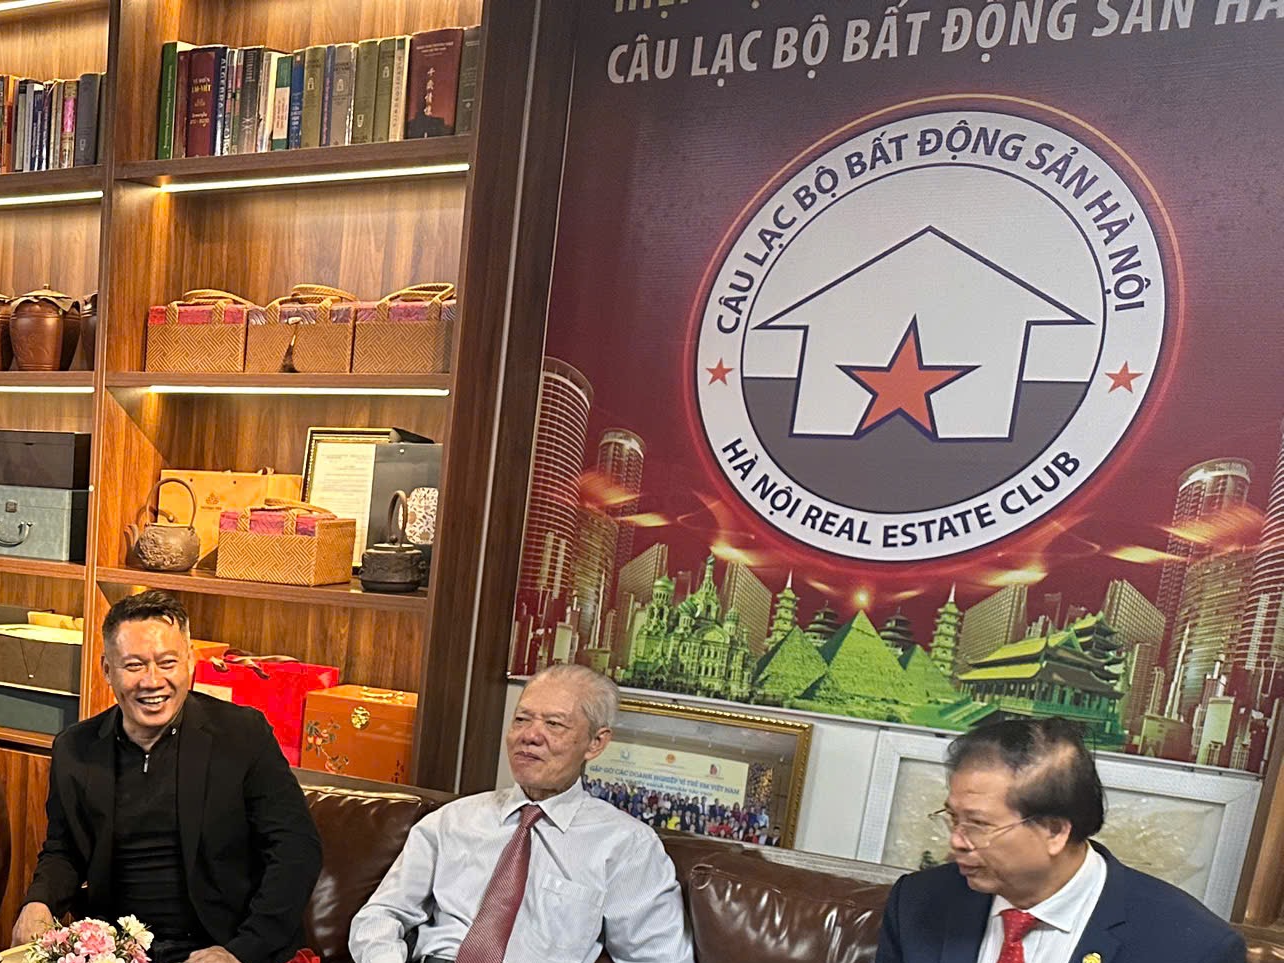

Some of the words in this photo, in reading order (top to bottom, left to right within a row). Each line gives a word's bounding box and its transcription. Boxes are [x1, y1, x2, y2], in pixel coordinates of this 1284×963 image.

[607, 34, 679, 84] CÂU
[691, 30, 763, 87] LẠC
[772, 14, 830, 79] BỘ
[842, 0, 931, 63] BẤT
[844, 131, 908, 179] BẤT
[917, 120, 1027, 162] ĐỘNG
[1025, 142, 1099, 199] SẢN
[792, 165, 839, 211] BỘ
[744, 205, 797, 266] LẠC
[1084, 190, 1135, 246] HÀ
[717, 270, 754, 334] CÂU
[1105, 245, 1151, 312] NỘI
[721, 437, 759, 482] HÀ
[751, 473, 802, 518] NỘI
[801, 504, 872, 545] REAL
[882, 502, 996, 548] ESTATE
[1000, 450, 1081, 515] CLUB
